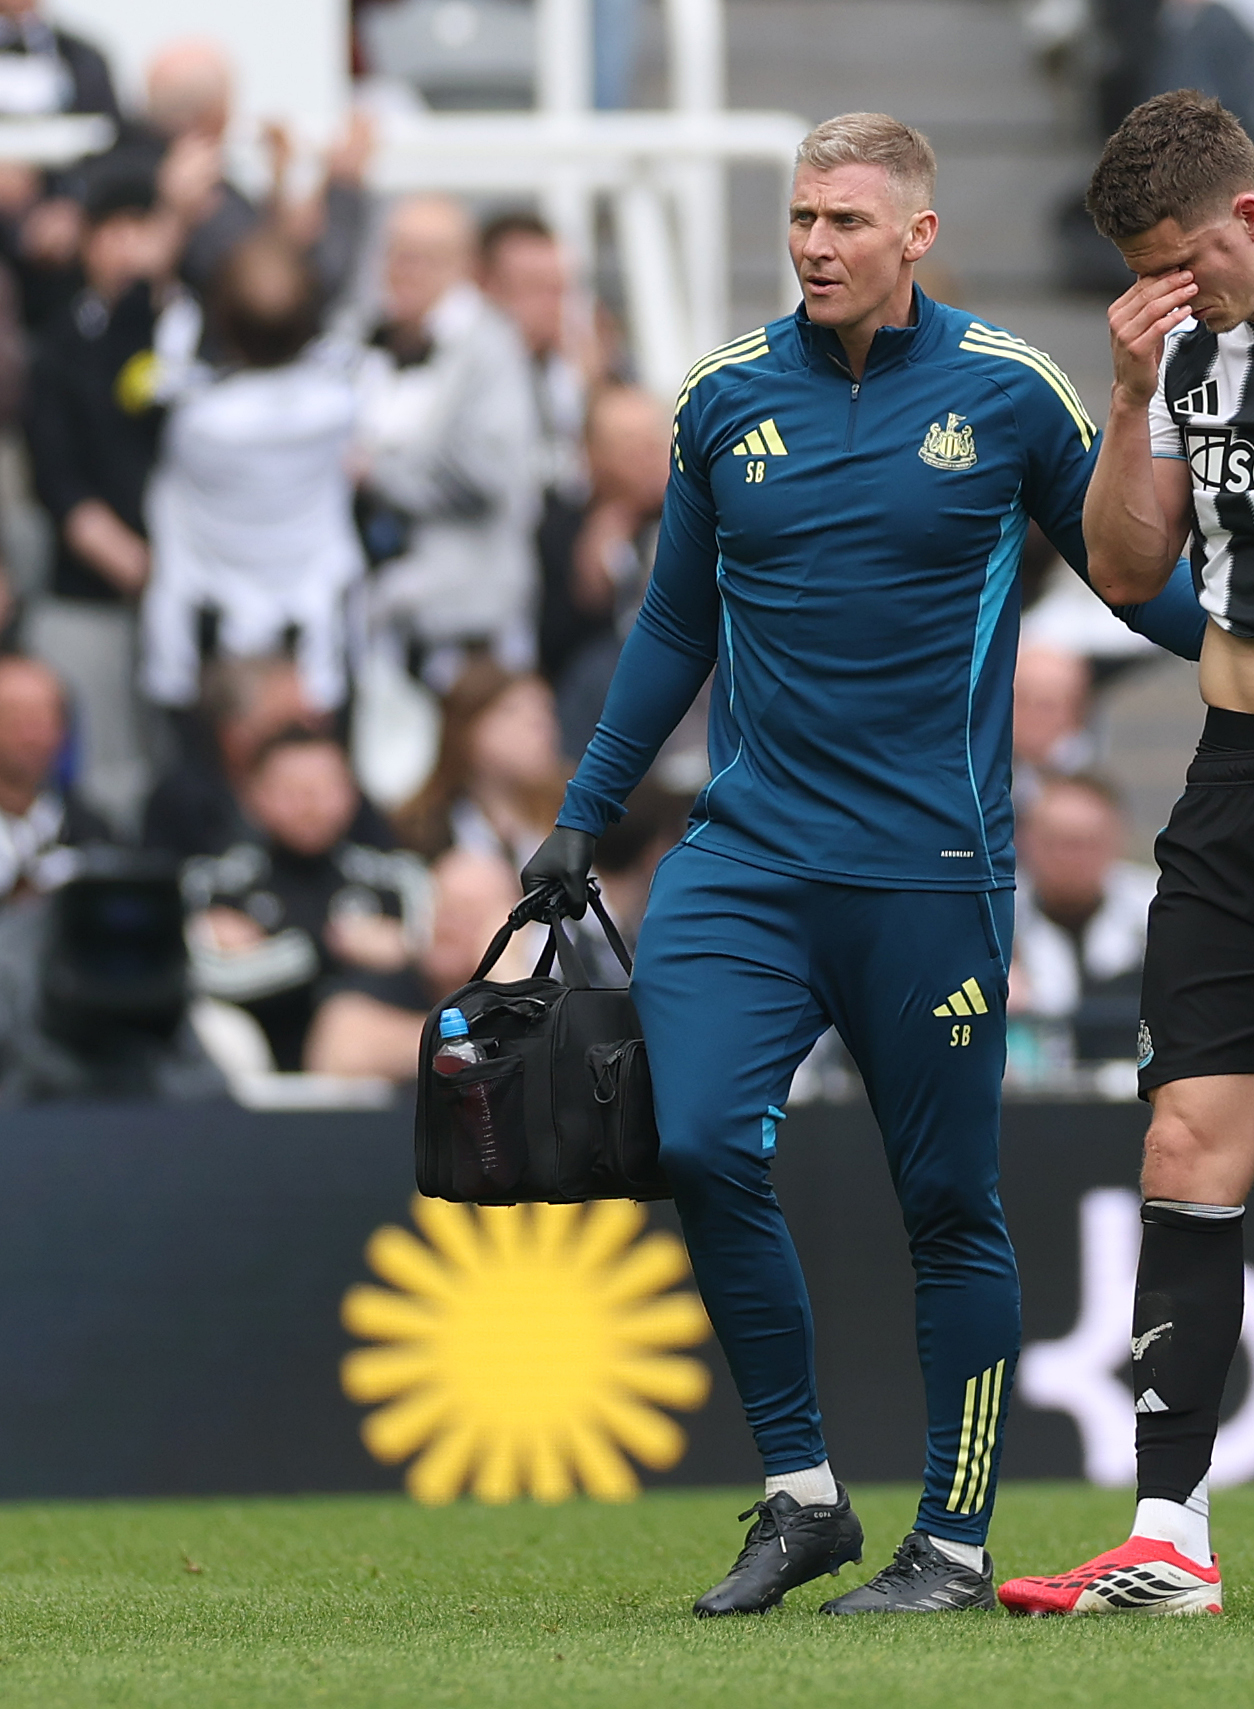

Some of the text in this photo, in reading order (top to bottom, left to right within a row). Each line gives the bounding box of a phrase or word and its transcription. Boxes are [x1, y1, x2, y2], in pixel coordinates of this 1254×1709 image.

[745, 460, 765, 483] SB
[949, 1024, 971, 1047] SB
[813, 1511, 832, 1519] COPA
